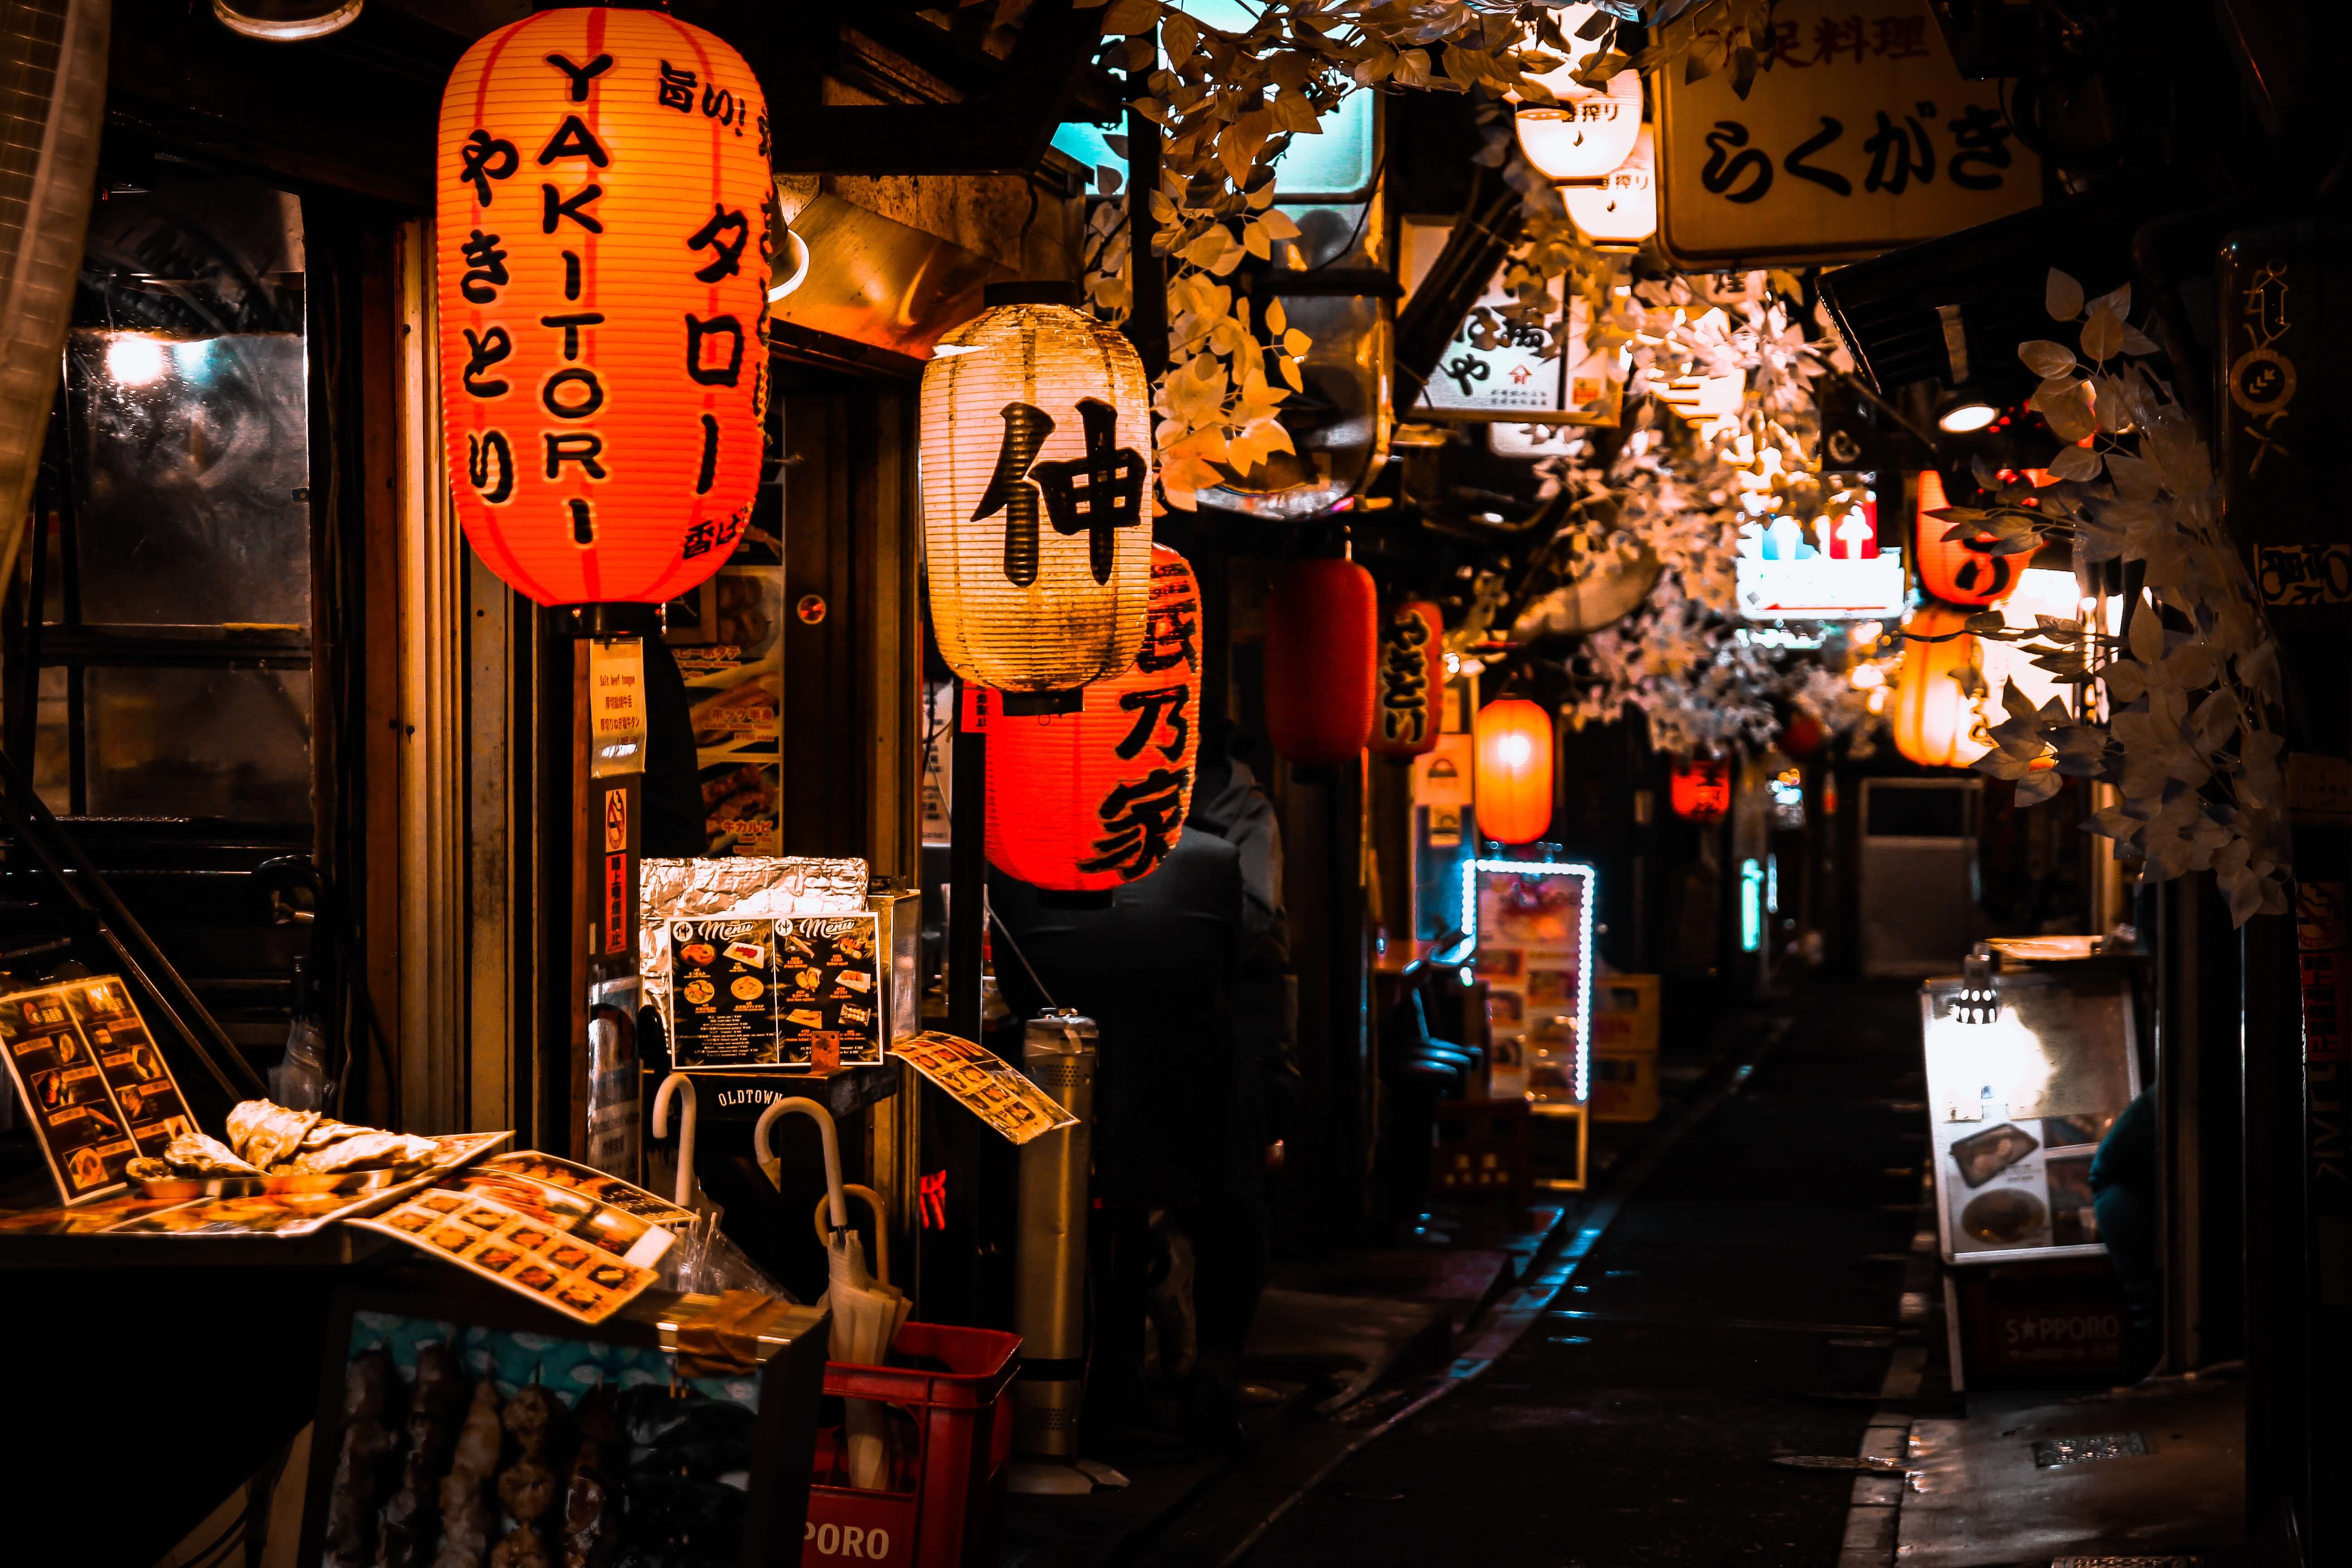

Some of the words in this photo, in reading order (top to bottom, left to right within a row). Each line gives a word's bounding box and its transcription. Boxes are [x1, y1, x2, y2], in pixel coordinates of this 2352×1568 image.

[1701, 102, 2012, 204] らくがき
[460, 129, 519, 504] やきとり
[538, 54, 613, 544] YAKITORI
[684, 203, 749, 495] タロー
[600, 675, 609, 686] Salt
[611, 674, 620, 686] beef
[622, 675, 635, 687] tongue
[1381, 609, 1430, 744] やきとり
[723, 821, 772, 834] 牛カルビ
[698, 921, 754, 941] Menu
[799, 917, 856, 938] Menu
[718, 1089, 783, 1106] OLDTOWN
